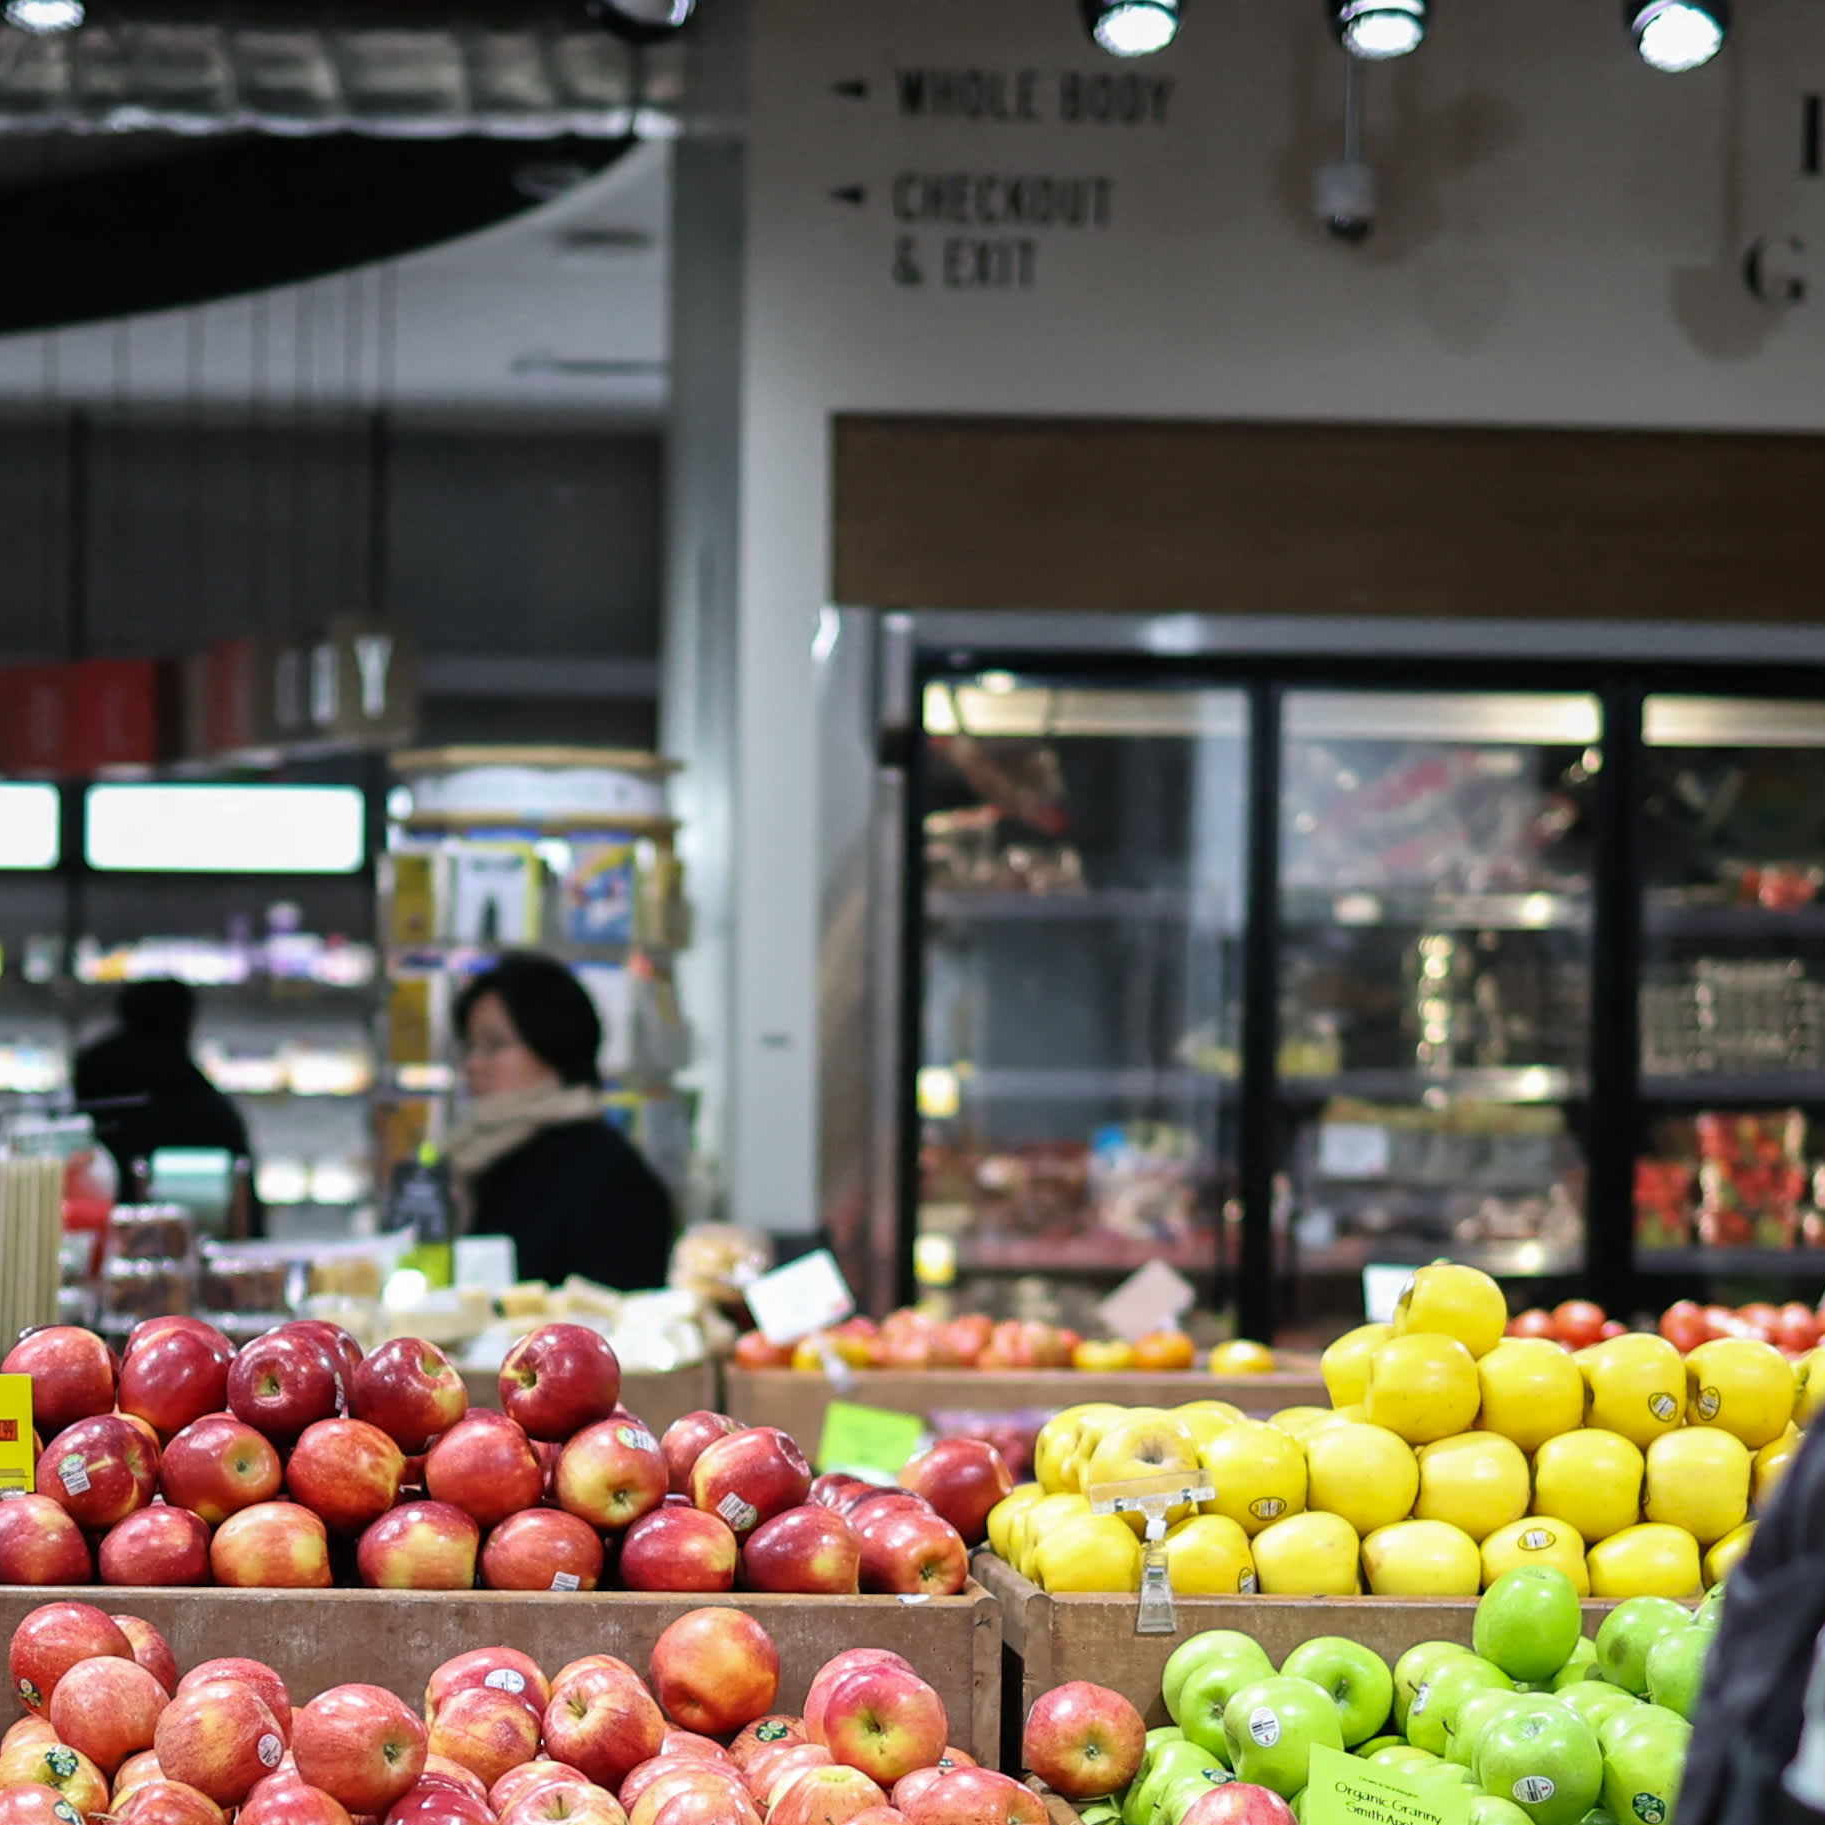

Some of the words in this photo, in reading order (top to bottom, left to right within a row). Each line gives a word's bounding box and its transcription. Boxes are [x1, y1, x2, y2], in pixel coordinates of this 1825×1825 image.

[896, 69, 1040, 122] WHOLE
[1060, 71, 1178, 125] BODY
[891, 171, 1115, 230] CHECKOUT
[892, 235, 923, 287] &
[942, 237, 1037, 290] EXIT
[1334, 1780, 1388, 1808] Organic
[1345, 1800, 1384, 1823] Smith
